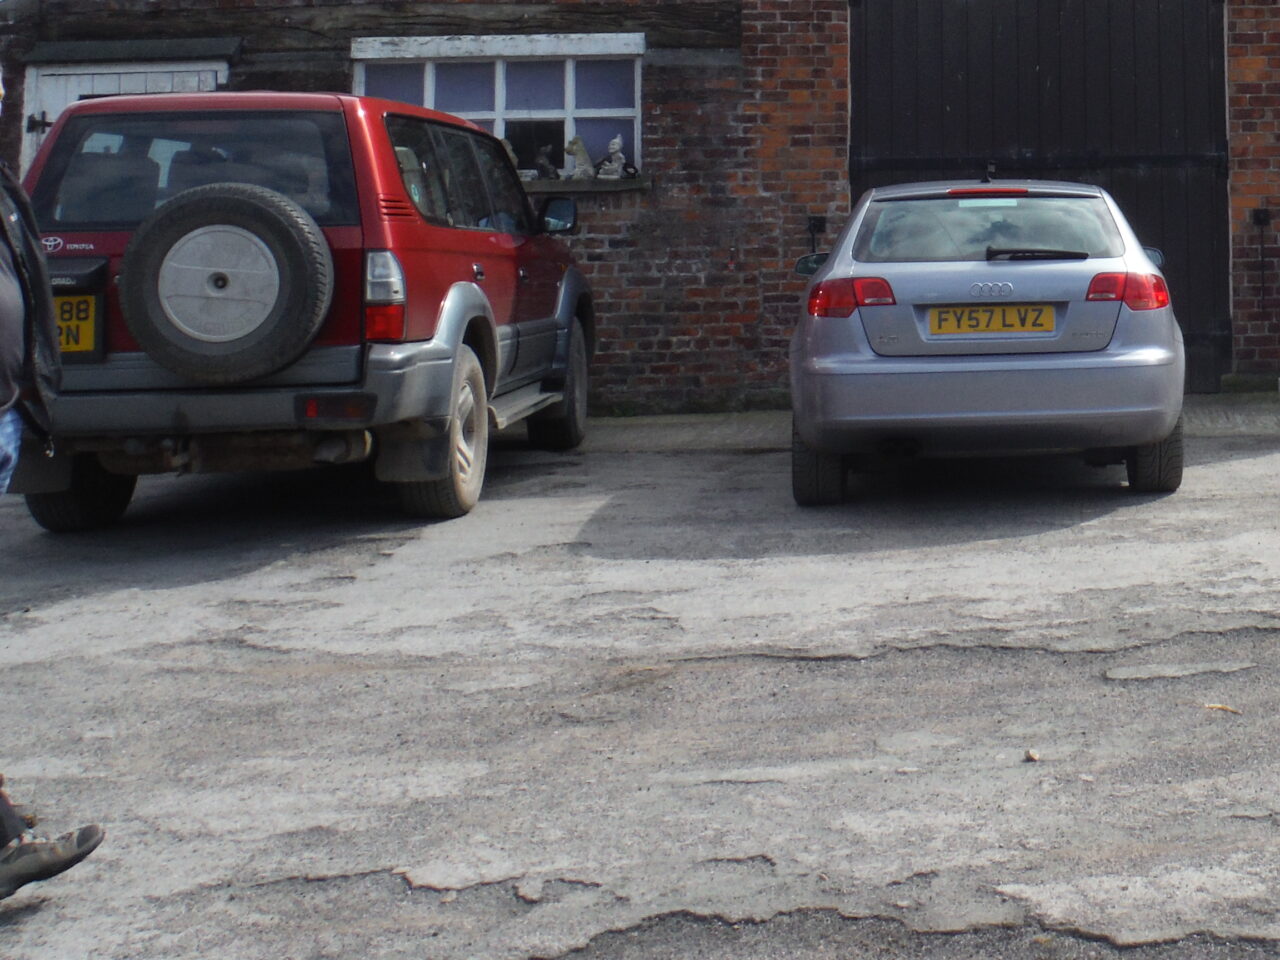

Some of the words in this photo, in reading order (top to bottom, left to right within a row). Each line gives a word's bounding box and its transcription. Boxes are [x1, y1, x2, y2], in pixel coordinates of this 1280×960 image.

[60, 299, 90, 321] 88
[937, 308, 995, 329] FY57
[1001, 308, 1045, 328] LVZ
